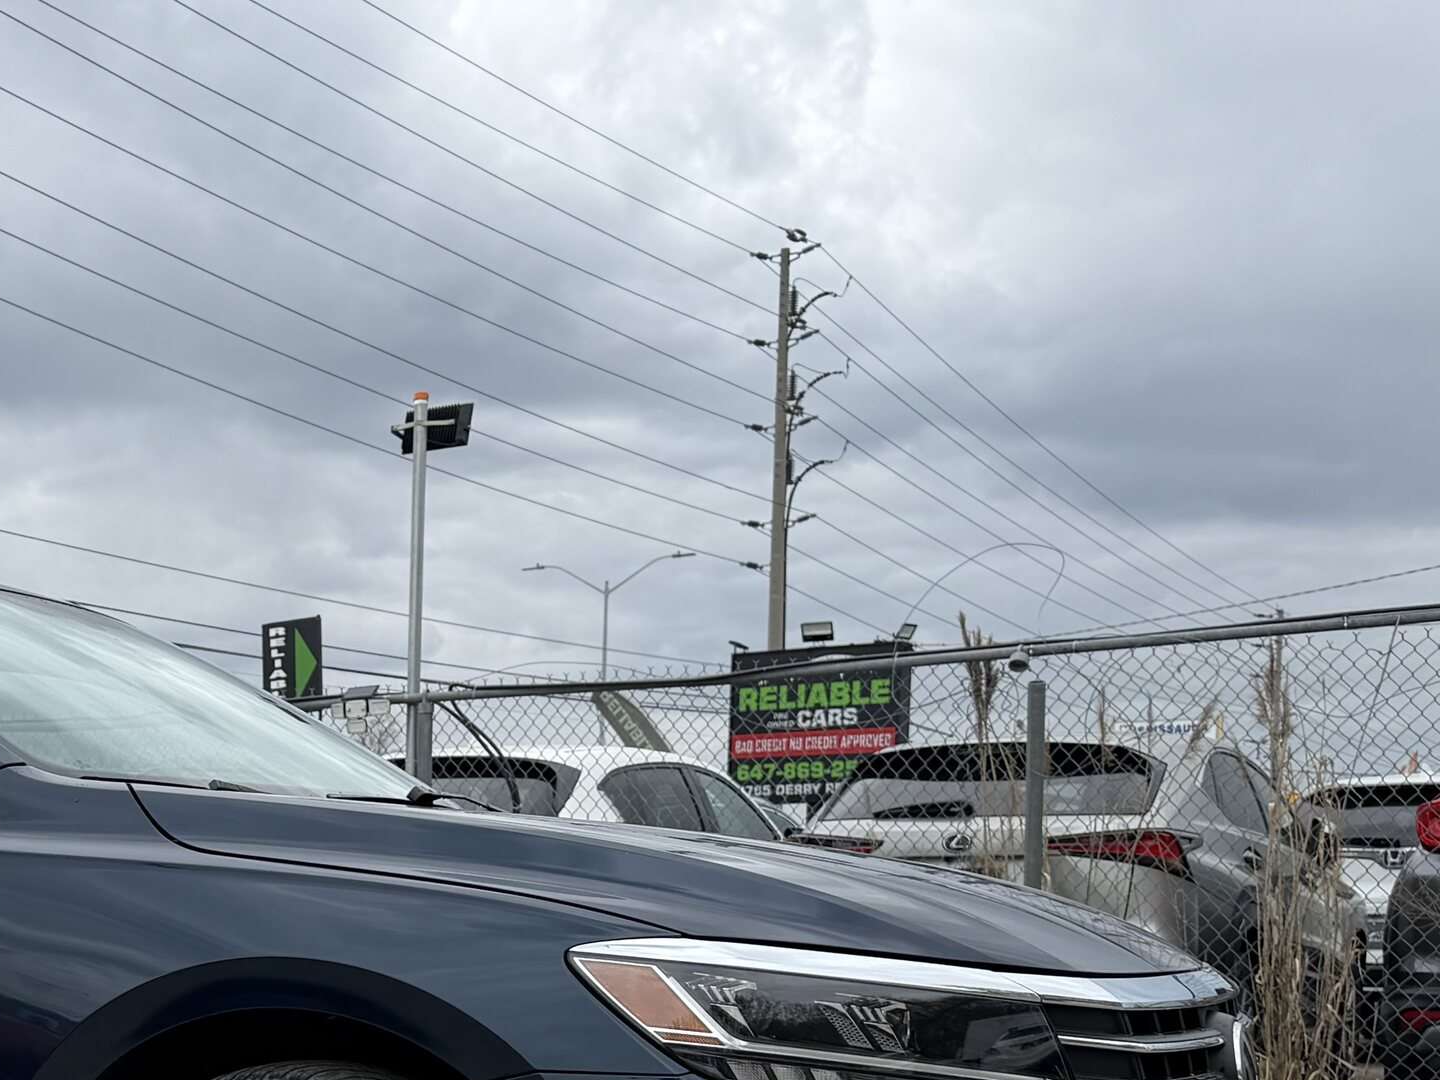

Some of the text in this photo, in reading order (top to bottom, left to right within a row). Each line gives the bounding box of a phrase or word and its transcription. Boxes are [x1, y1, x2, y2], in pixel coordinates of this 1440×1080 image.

[268, 626, 288, 698] RELIABL
[738, 678, 891, 712] RELIABLE
[796, 707, 859, 728] CARS
[805, 735, 838, 750] CREDIT
[840, 732, 892, 749] APPROVED
[736, 759, 860, 782] 647-869-25
[775, 782, 822, 796] DERRY
